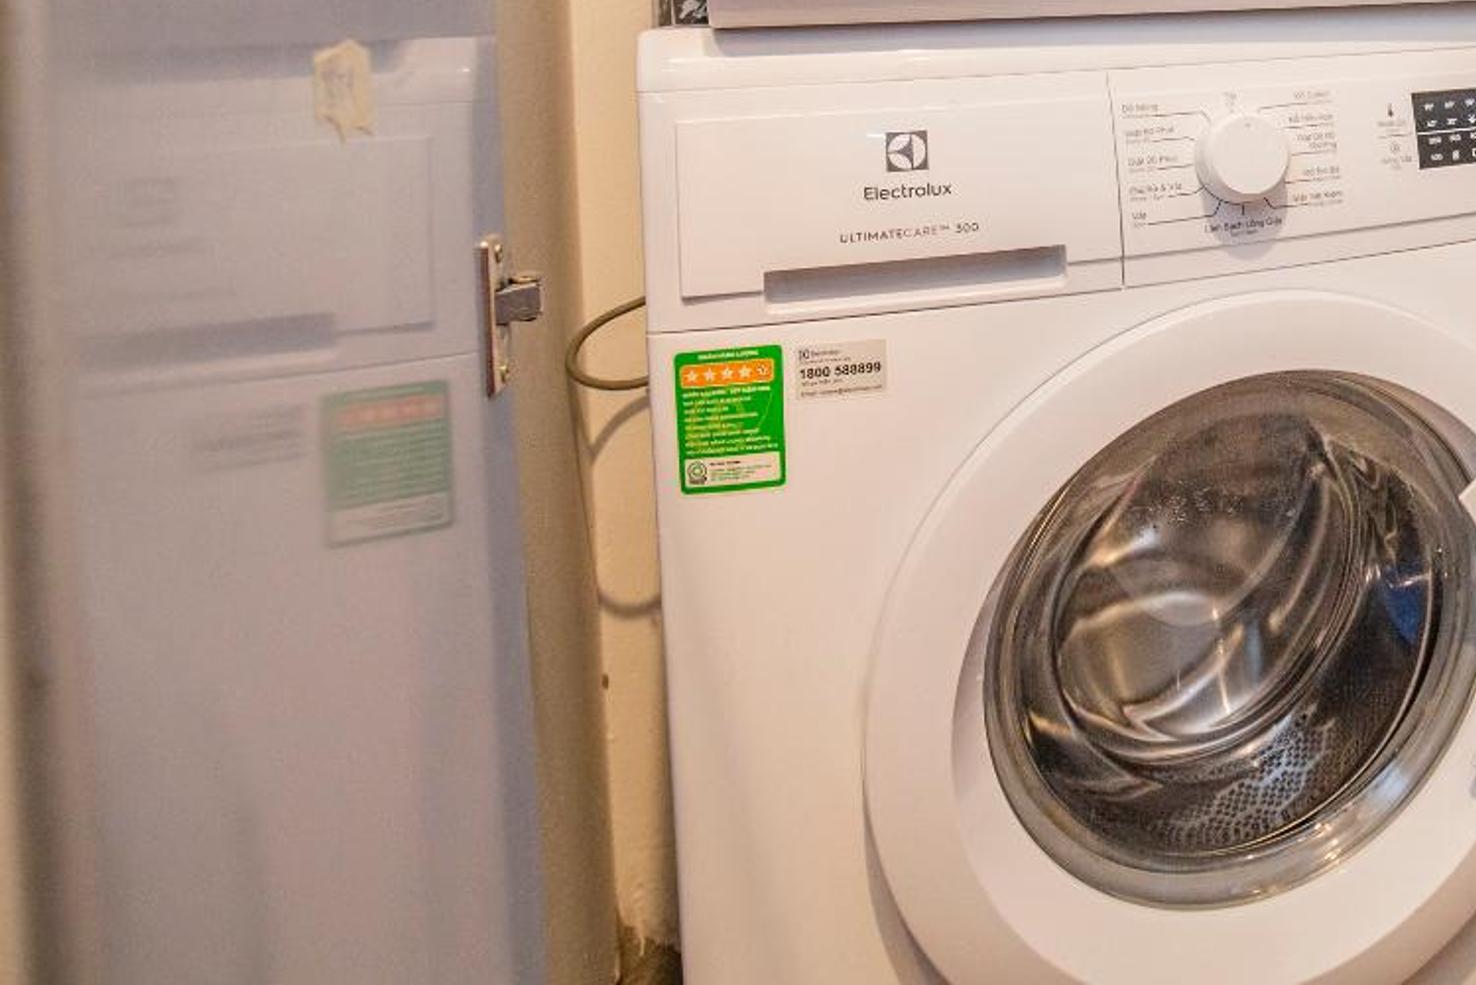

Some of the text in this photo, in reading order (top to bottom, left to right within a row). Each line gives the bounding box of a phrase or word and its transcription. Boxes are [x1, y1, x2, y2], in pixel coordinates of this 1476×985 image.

[863, 183, 952, 200] Electrolux
[800, 366, 831, 380] 1800
[834, 361, 882, 376] 588899
